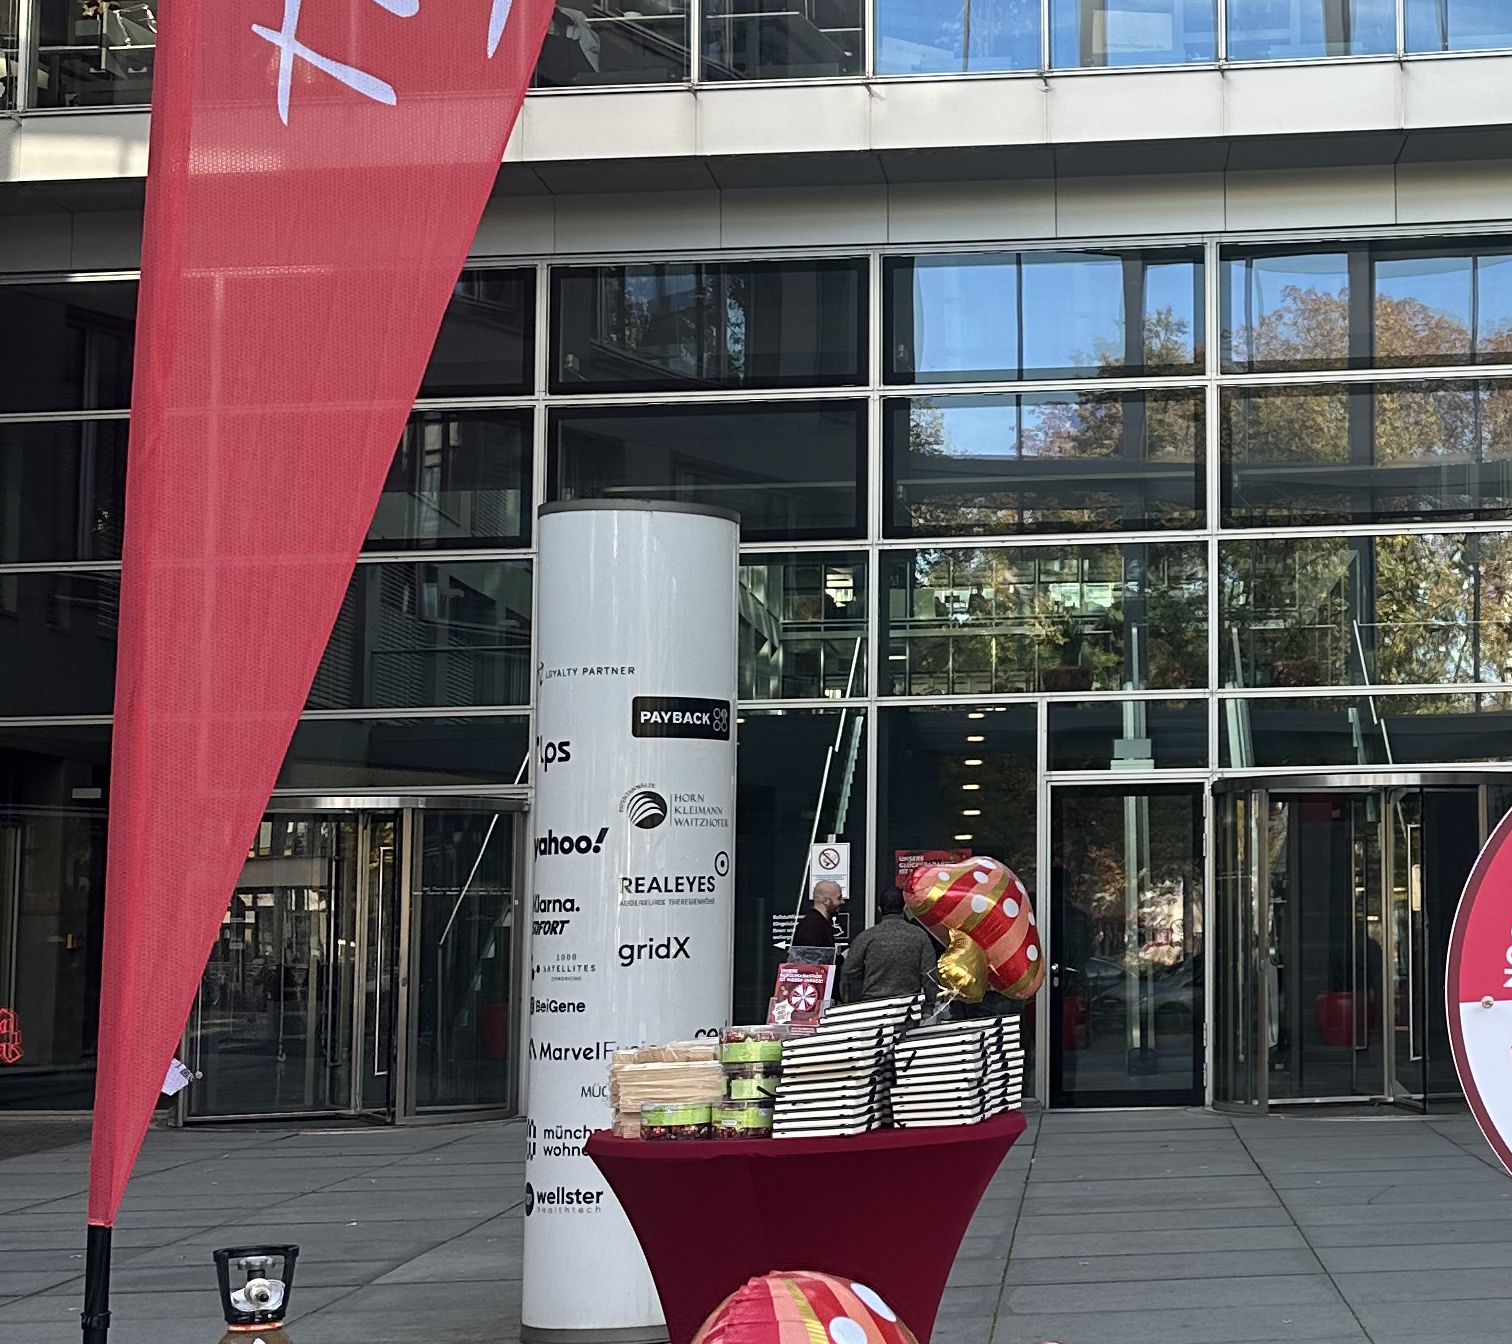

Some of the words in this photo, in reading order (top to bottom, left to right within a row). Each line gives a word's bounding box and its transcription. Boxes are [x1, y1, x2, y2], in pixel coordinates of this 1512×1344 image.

[582, 667, 635, 675] PARTNER
[640, 711, 711, 726] PAYBACK
[674, 794, 705, 803] HORN
[534, 827, 609, 863] yahoo!
[620, 876, 716, 894] REALEYES
[618, 936, 691, 967] gridX
[539, 1041, 600, 1061] Marvel
[537, 1187, 604, 1205] wellster
